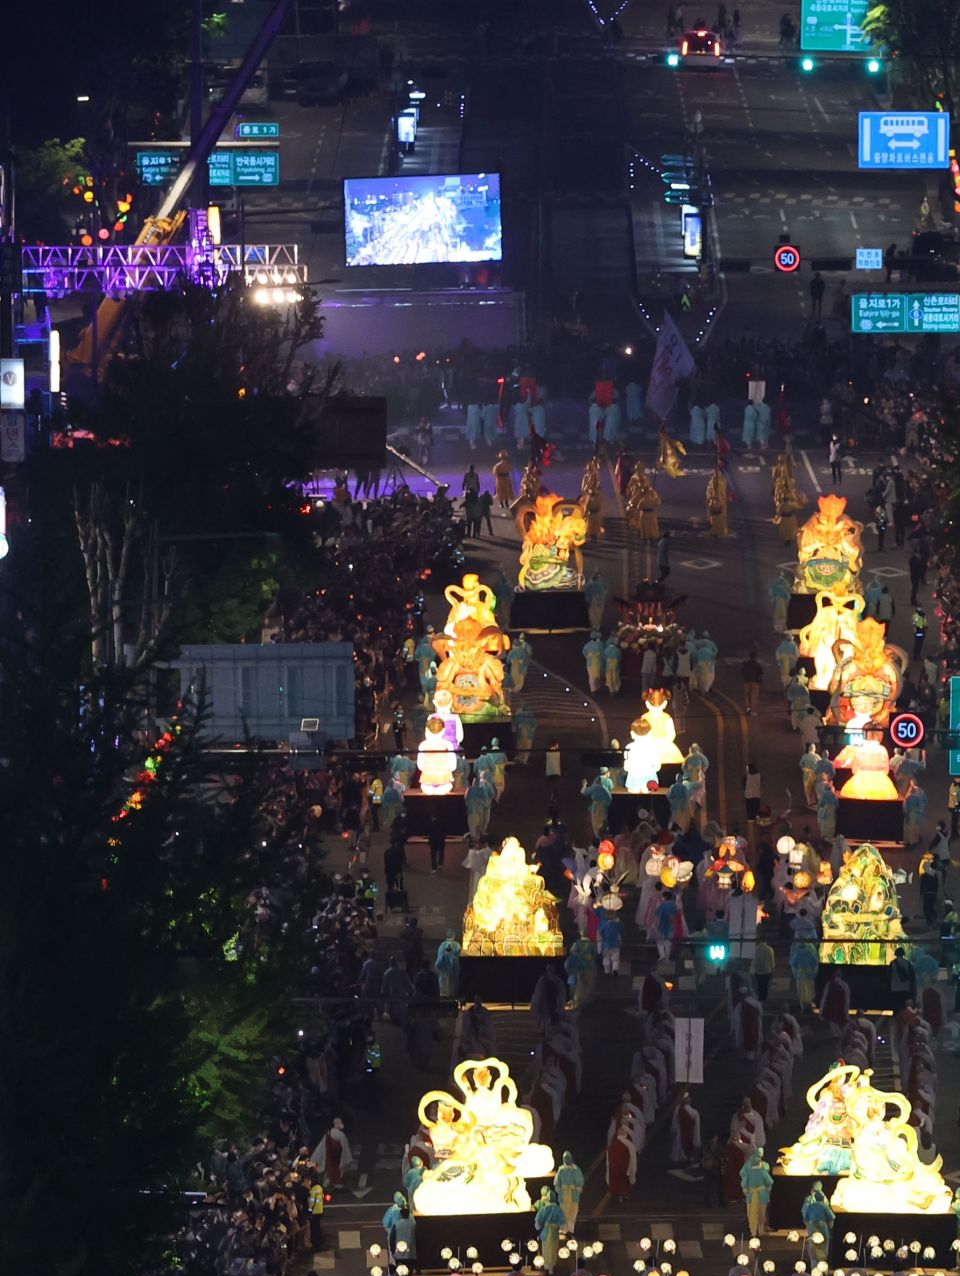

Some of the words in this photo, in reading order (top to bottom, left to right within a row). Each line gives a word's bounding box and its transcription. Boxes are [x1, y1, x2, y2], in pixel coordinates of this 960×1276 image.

[874, 152, 934, 163] 중앙차로버스전용
[780, 252, 794, 265] 50
[859, 298, 900, 308] 을지로1가
[897, 722, 917, 739] 50
